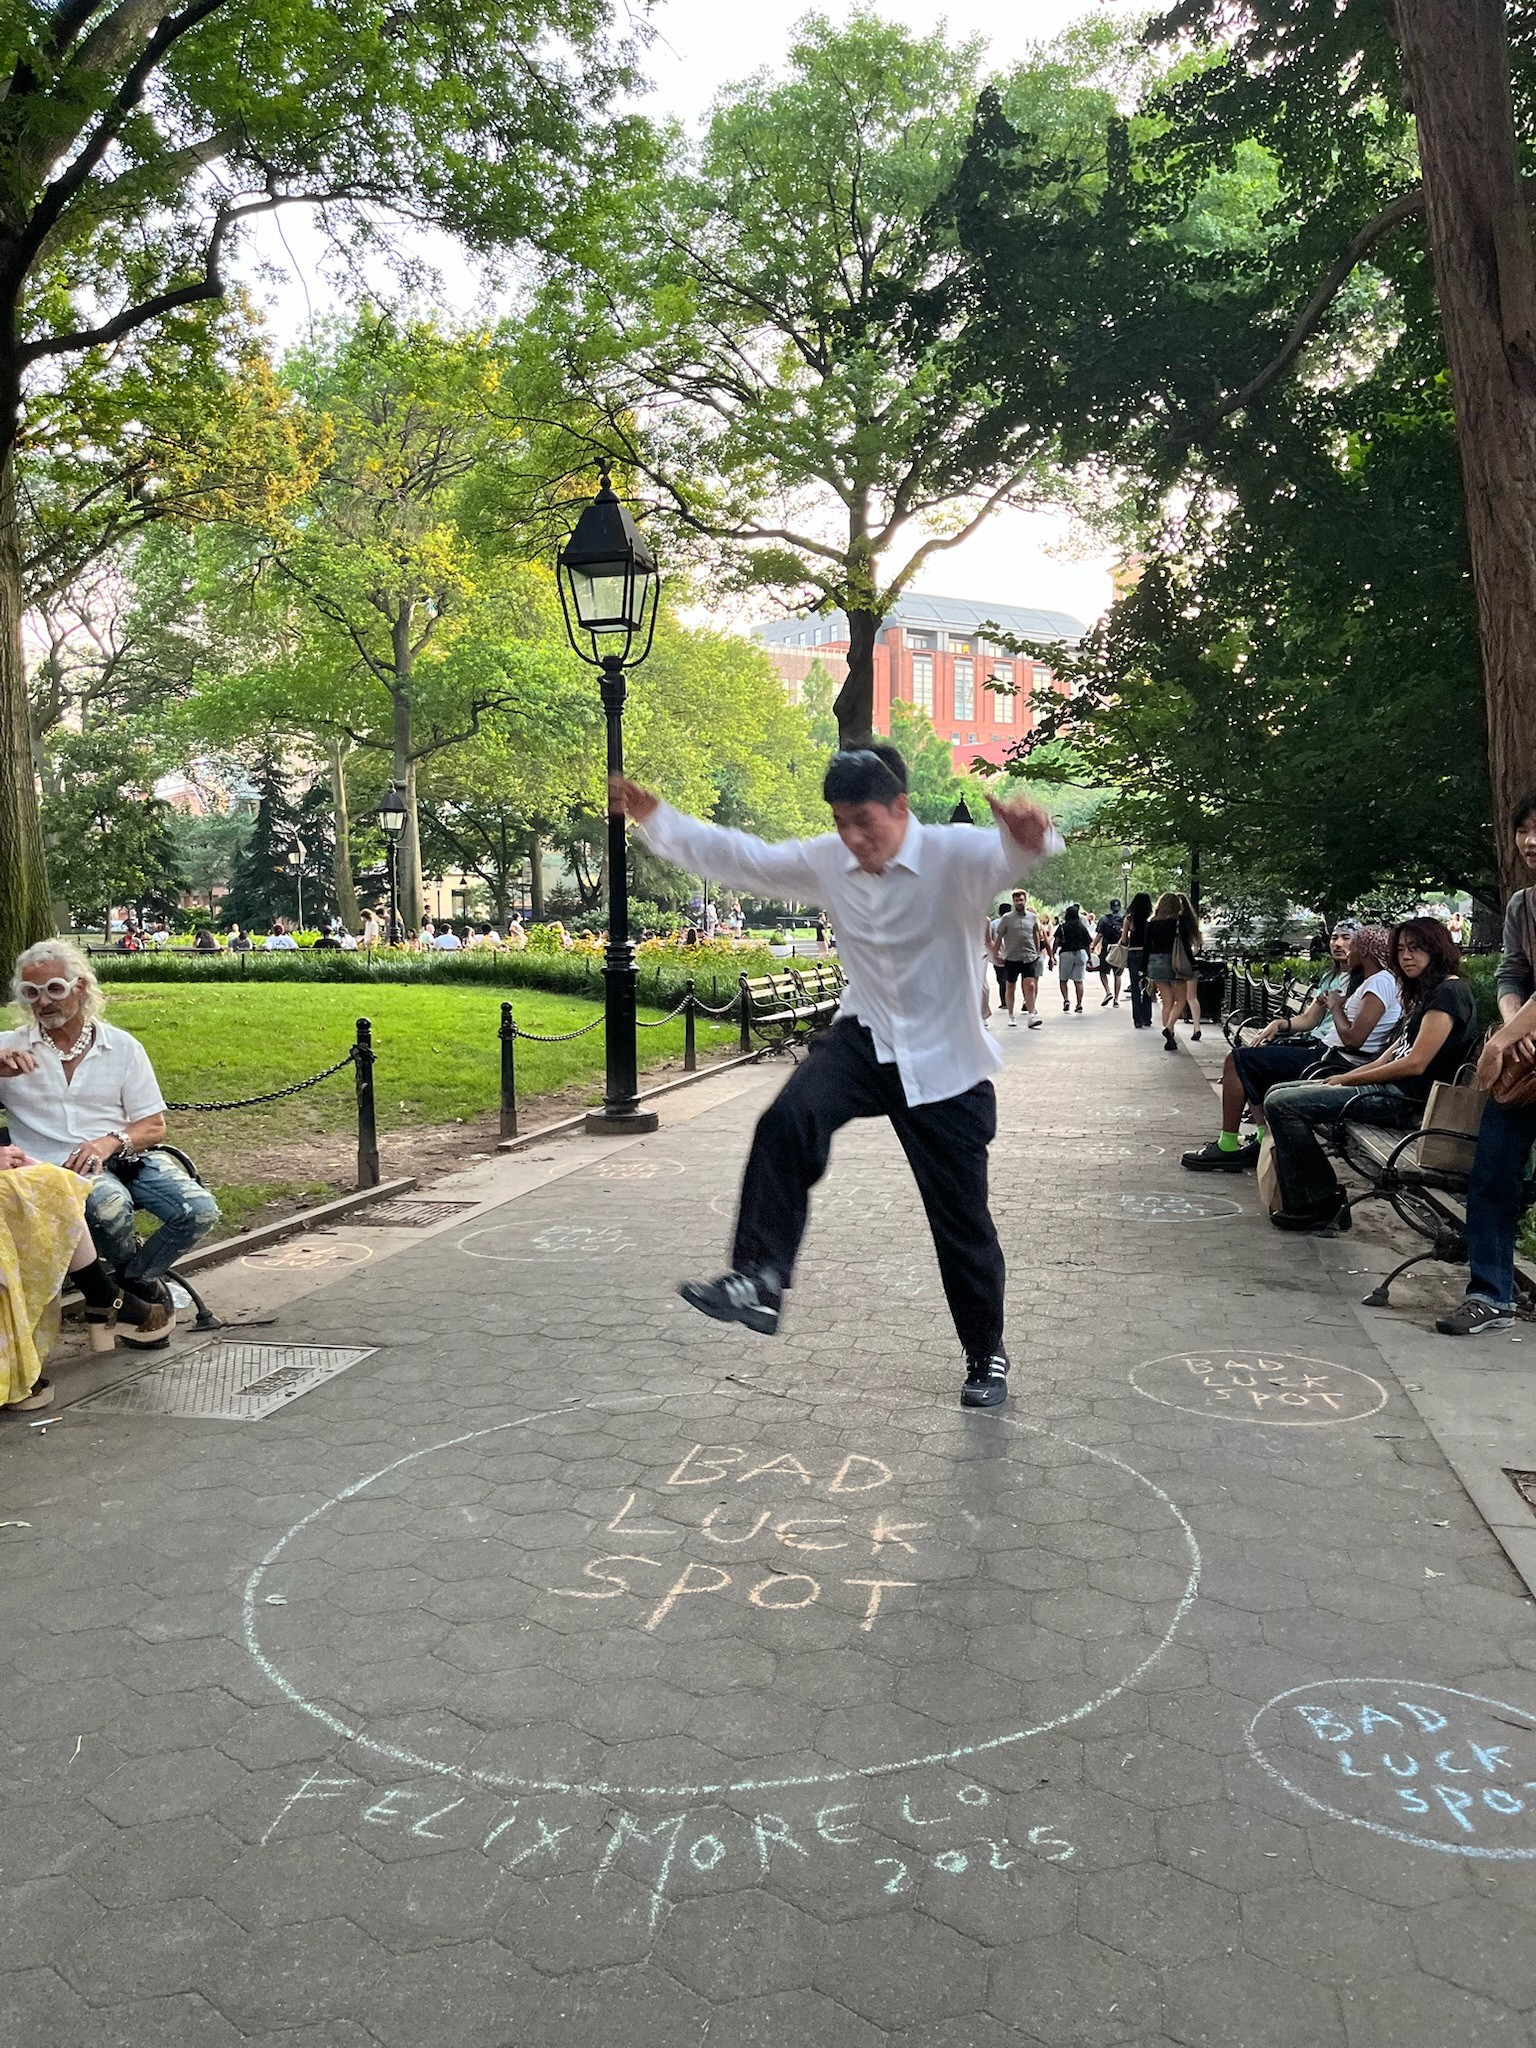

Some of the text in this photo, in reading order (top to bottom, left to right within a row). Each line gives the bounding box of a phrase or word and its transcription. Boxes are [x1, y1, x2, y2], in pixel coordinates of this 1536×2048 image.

[534, 1242, 638, 1253] SPOT
[1181, 1358, 1285, 1375] BAD
[1203, 1374, 1330, 1388] LUCK
[1214, 1388, 1344, 1411] SPOT
[667, 1443, 894, 1493] BAD
[607, 1492, 928, 1556] LUCK
[547, 1553, 919, 1632] SPOT
[1294, 1701, 1448, 1742] BAD
[1336, 1740, 1512, 1778] LUCK
[261, 1770, 573, 1868] FELIX
[1394, 1781, 1536, 1833] SPO
[874, 1824, 1078, 1893] 2025
